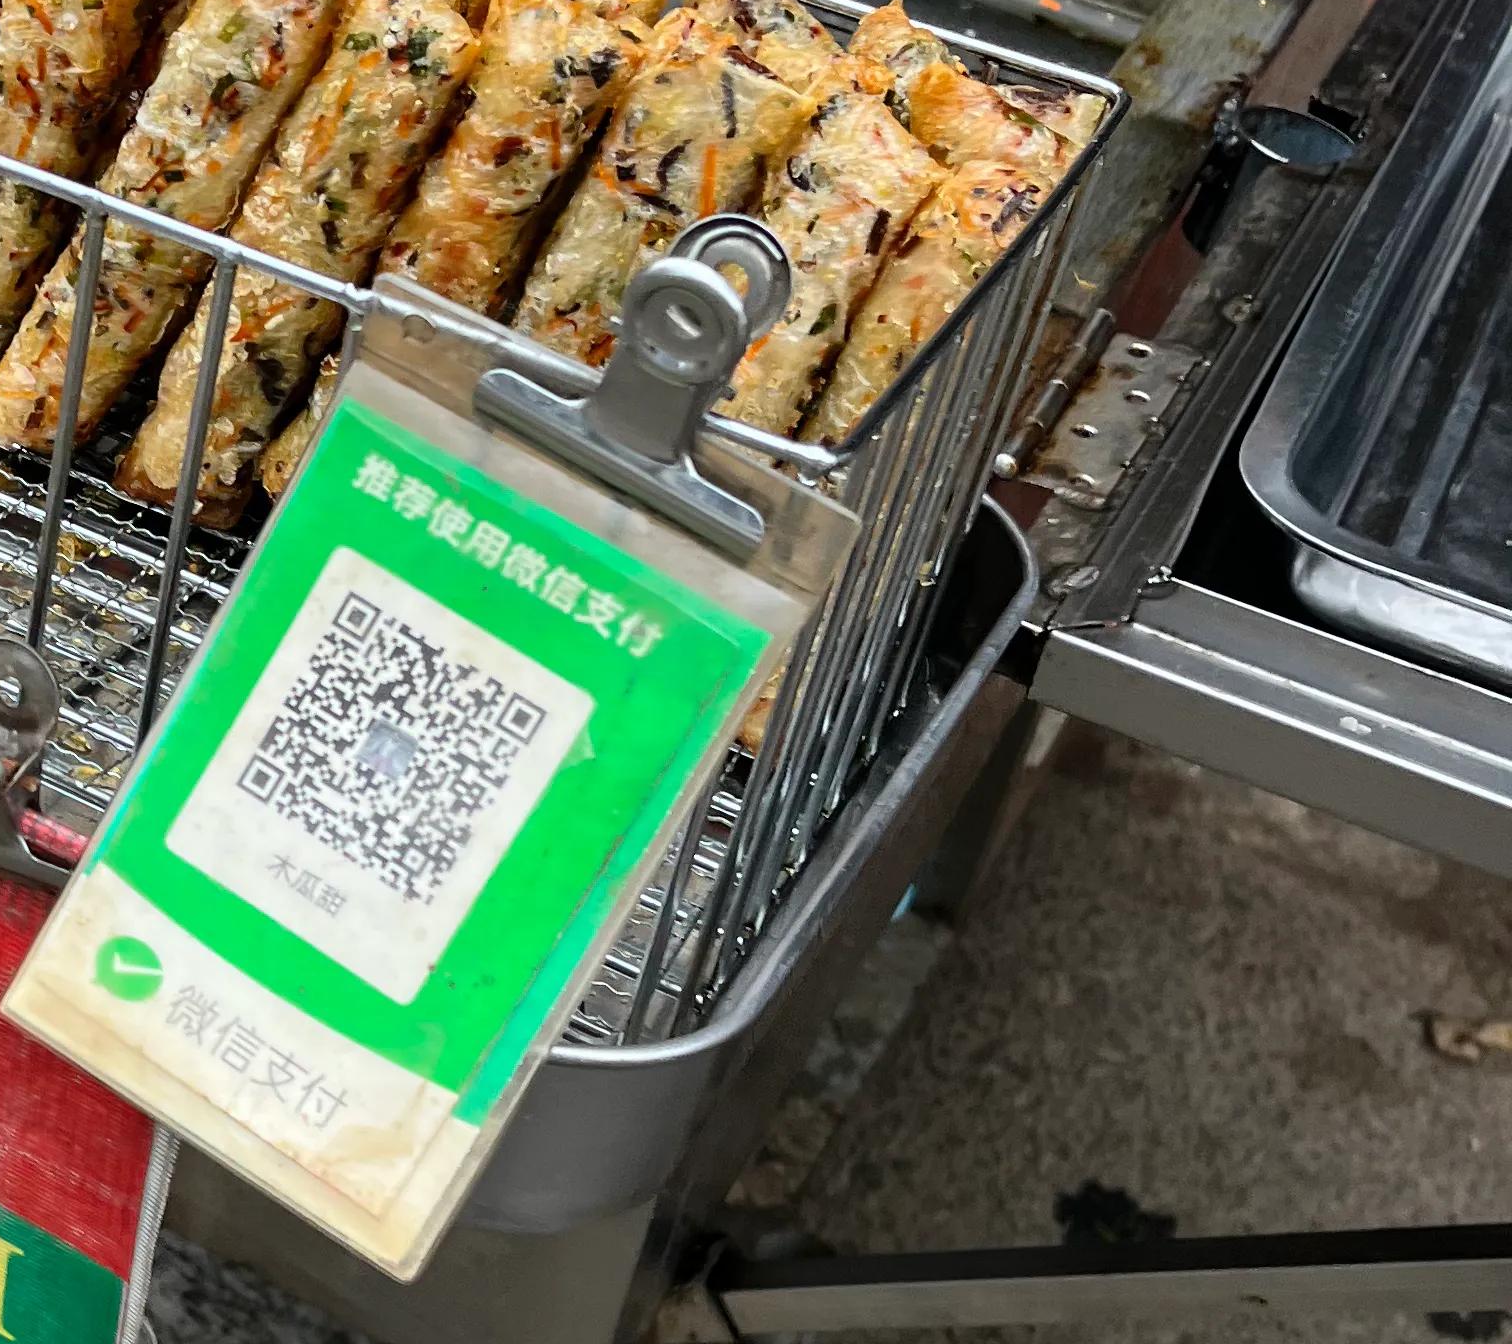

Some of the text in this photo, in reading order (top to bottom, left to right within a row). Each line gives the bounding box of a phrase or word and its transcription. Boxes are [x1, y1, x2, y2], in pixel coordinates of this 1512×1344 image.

[352, 453, 665, 659] 推荐使用微信支付
[165, 984, 349, 1130] 微信支付
